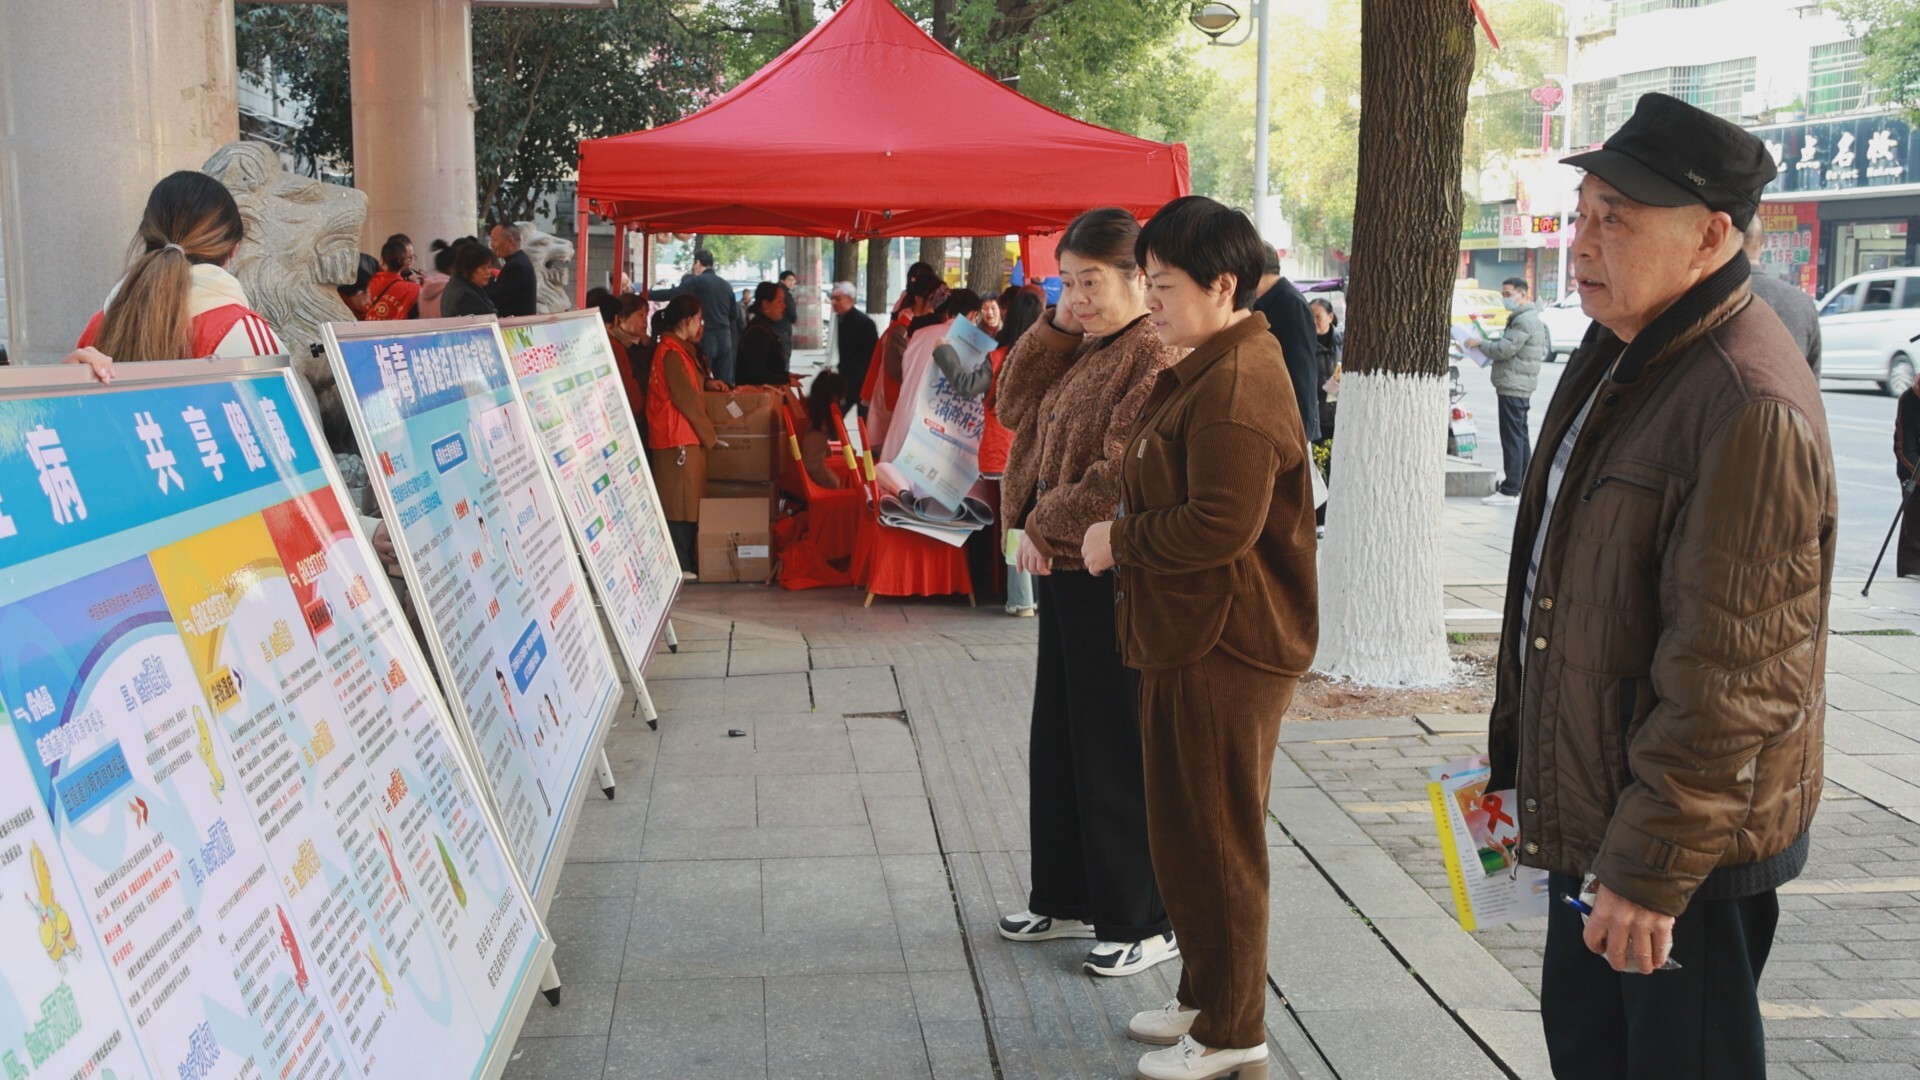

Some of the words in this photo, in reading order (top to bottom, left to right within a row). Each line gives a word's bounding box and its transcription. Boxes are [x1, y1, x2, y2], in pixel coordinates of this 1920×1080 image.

[373, 343, 417, 402] 梅毒
[0, 423, 88, 540] 病
[133, 396, 297, 496] 共享健康
